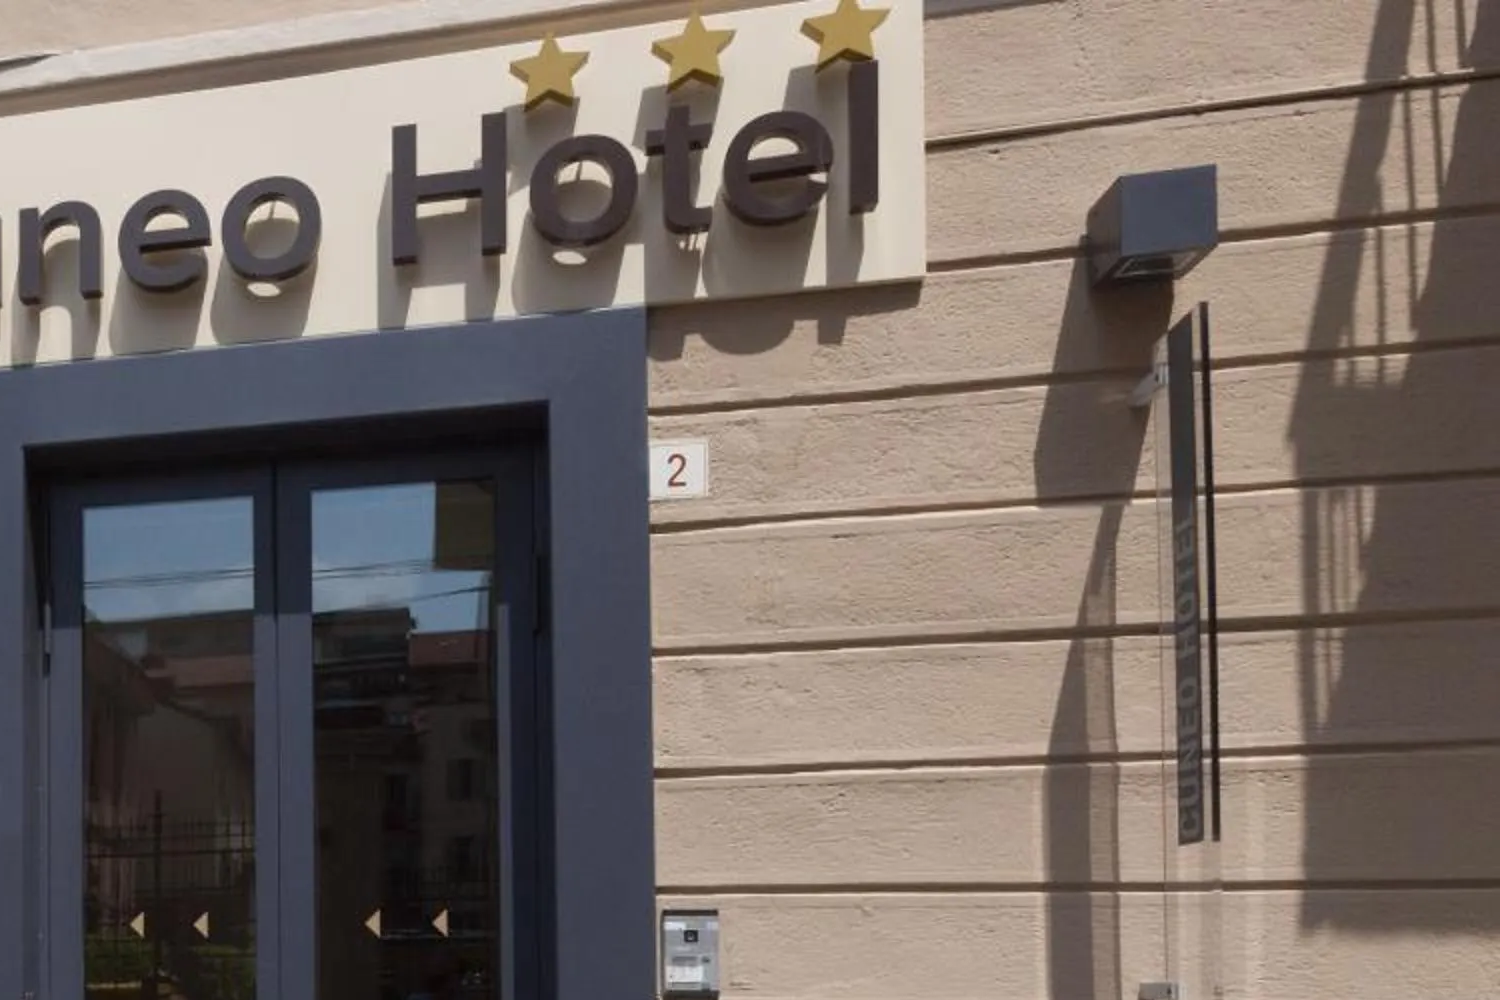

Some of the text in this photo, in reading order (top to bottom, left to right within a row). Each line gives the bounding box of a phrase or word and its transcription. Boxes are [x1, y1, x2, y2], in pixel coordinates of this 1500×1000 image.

[391, 58, 879, 268] Hotel
[667, 453, 687, 487] 2
[1175, 511, 1200, 836] CUNEO HOTEL
